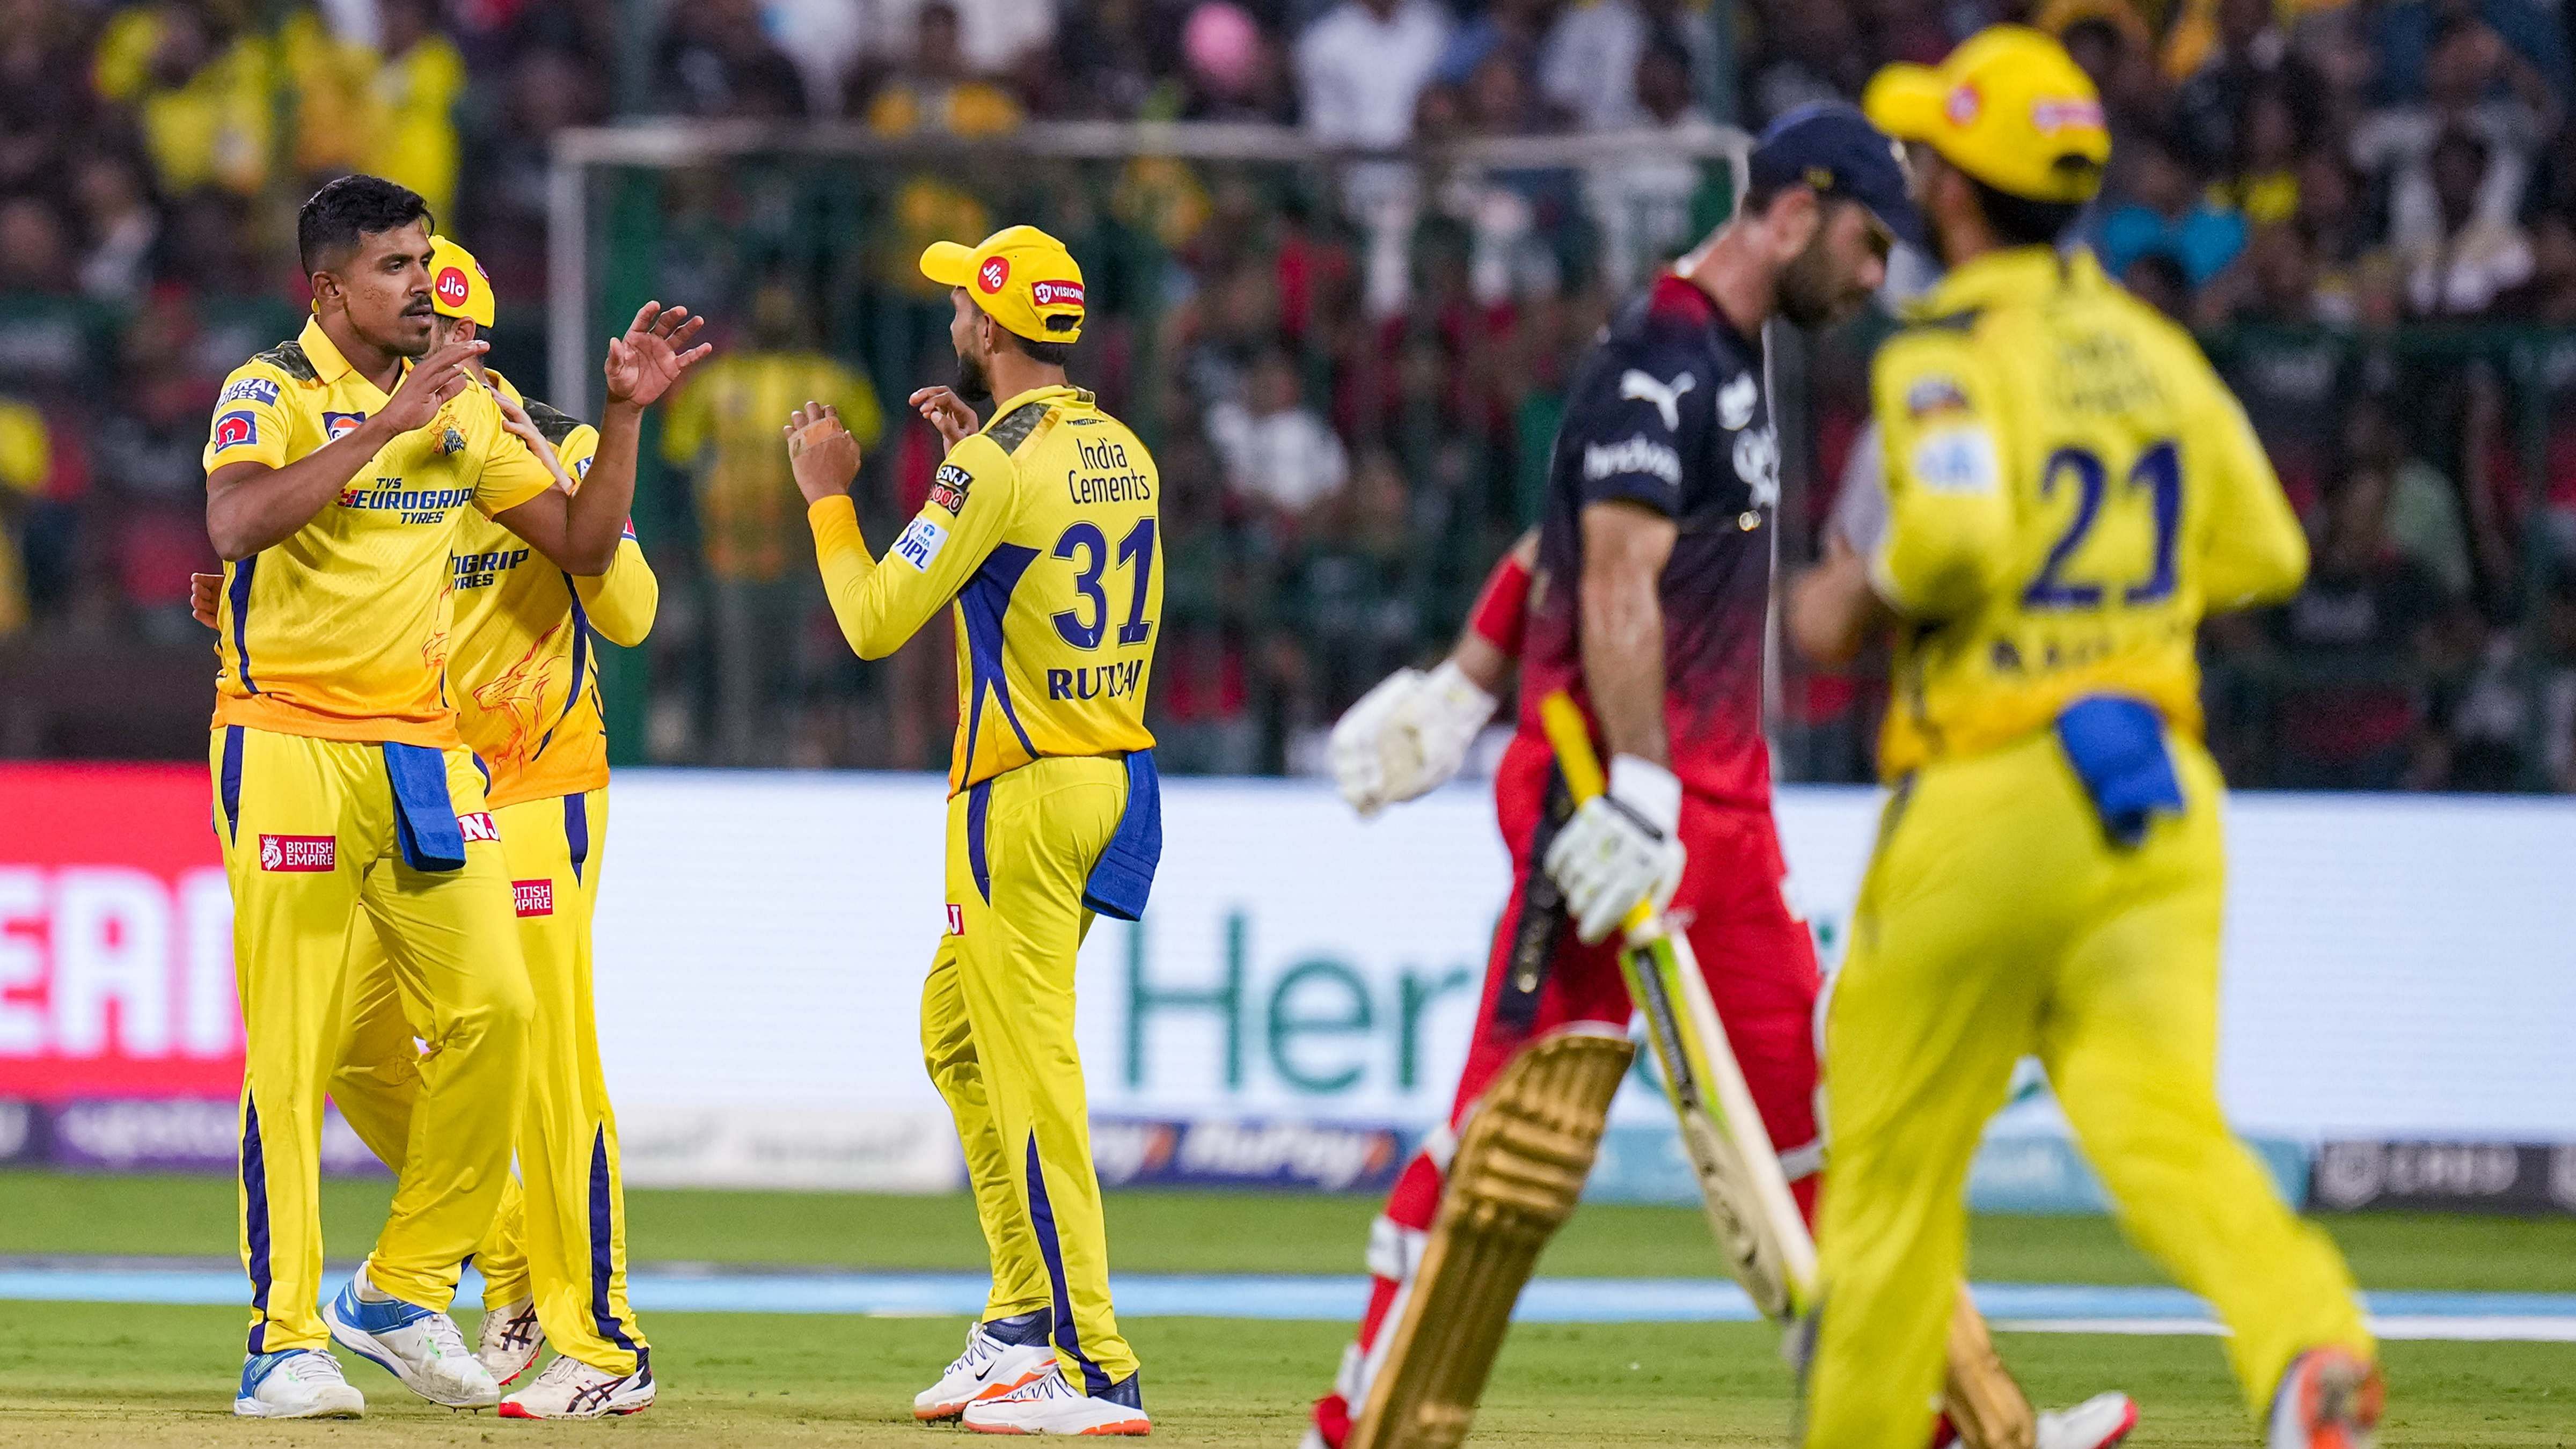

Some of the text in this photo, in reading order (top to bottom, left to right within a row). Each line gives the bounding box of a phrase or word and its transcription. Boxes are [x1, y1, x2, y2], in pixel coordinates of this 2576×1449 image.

[439, 276, 465, 297] Jio
[983, 264, 1002, 288] Jio
[1076, 437, 1128, 470] India
[376, 478, 402, 489] TVS
[1069, 468, 1151, 504] Cements
[352, 488, 473, 510] EUROGRIP
[400, 511, 444, 524] TYRES
[2022, 439, 2180, 609] 21
[915, 533, 931, 548] TATA
[902, 539, 928, 569] IPL
[1050, 515, 1157, 651] 31
[457, 813, 500, 841] NJ
[286, 841, 334, 854] BRITISH
[286, 853, 334, 866] EMPIRE
[512, 885, 550, 899] RITISH
[515, 897, 552, 911] MPIRE
[1125, 907, 1472, 1096] Her
